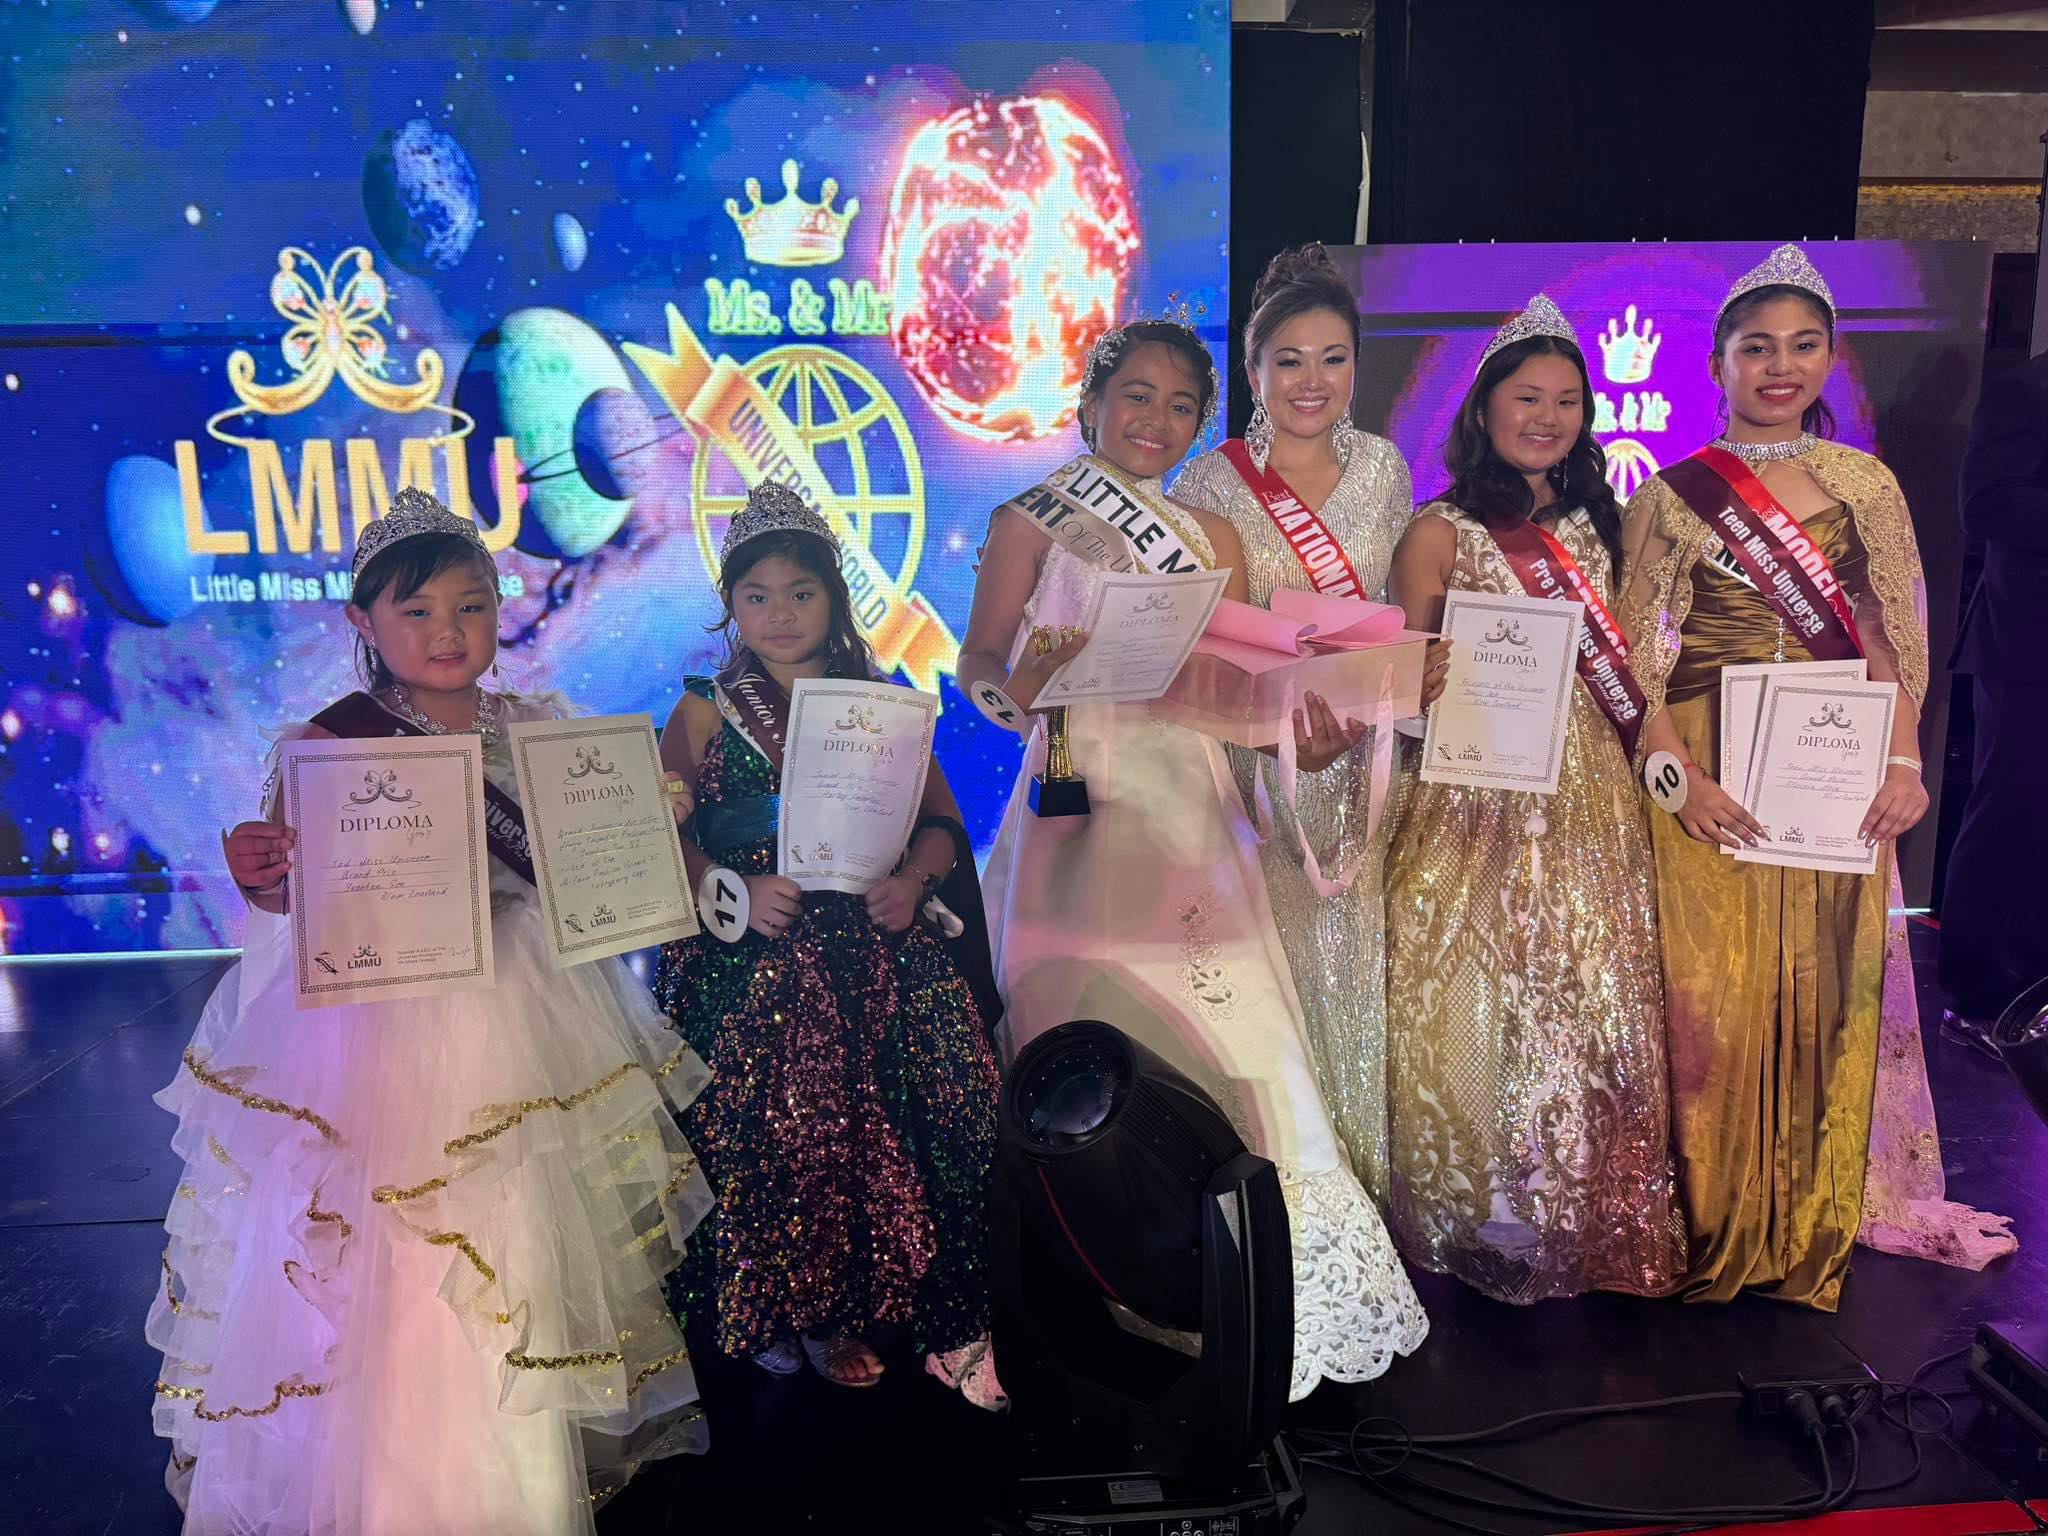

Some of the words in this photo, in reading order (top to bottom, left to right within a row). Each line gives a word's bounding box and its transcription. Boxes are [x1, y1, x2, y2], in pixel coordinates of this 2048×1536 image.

[788, 276, 827, 336] &
[173, 436, 522, 556] LMMU
[1065, 467, 1166, 555] LITTLE
[1262, 488, 1293, 504] Best
[1061, 519, 1090, 546] Of
[190, 573, 257, 602] Little
[258, 572, 322, 602] Miss
[1529, 557, 1556, 590] Pre
[1717, 506, 1751, 541] Teen
[1743, 534, 1779, 576] Miss
[1771, 568, 1825, 635] Universe
[1473, 650, 1538, 668] DIPLOMA
[722, 673, 777, 729] Junior
[1591, 655, 1638, 721] Universe
[980, 689, 1015, 724] 13
[823, 739, 895, 759] DIPLOMA
[1797, 735, 1861, 751] DIPLOMA
[564, 783, 635, 805] DIPLOMA
[1655, 763, 1680, 799] 10
[339, 814, 433, 833] DIPLOMA
[485, 799, 532, 859] ivers
[714, 878, 738, 929] 17
[590, 914, 617, 928] LMMU
[347, 957, 382, 970] LMMU
